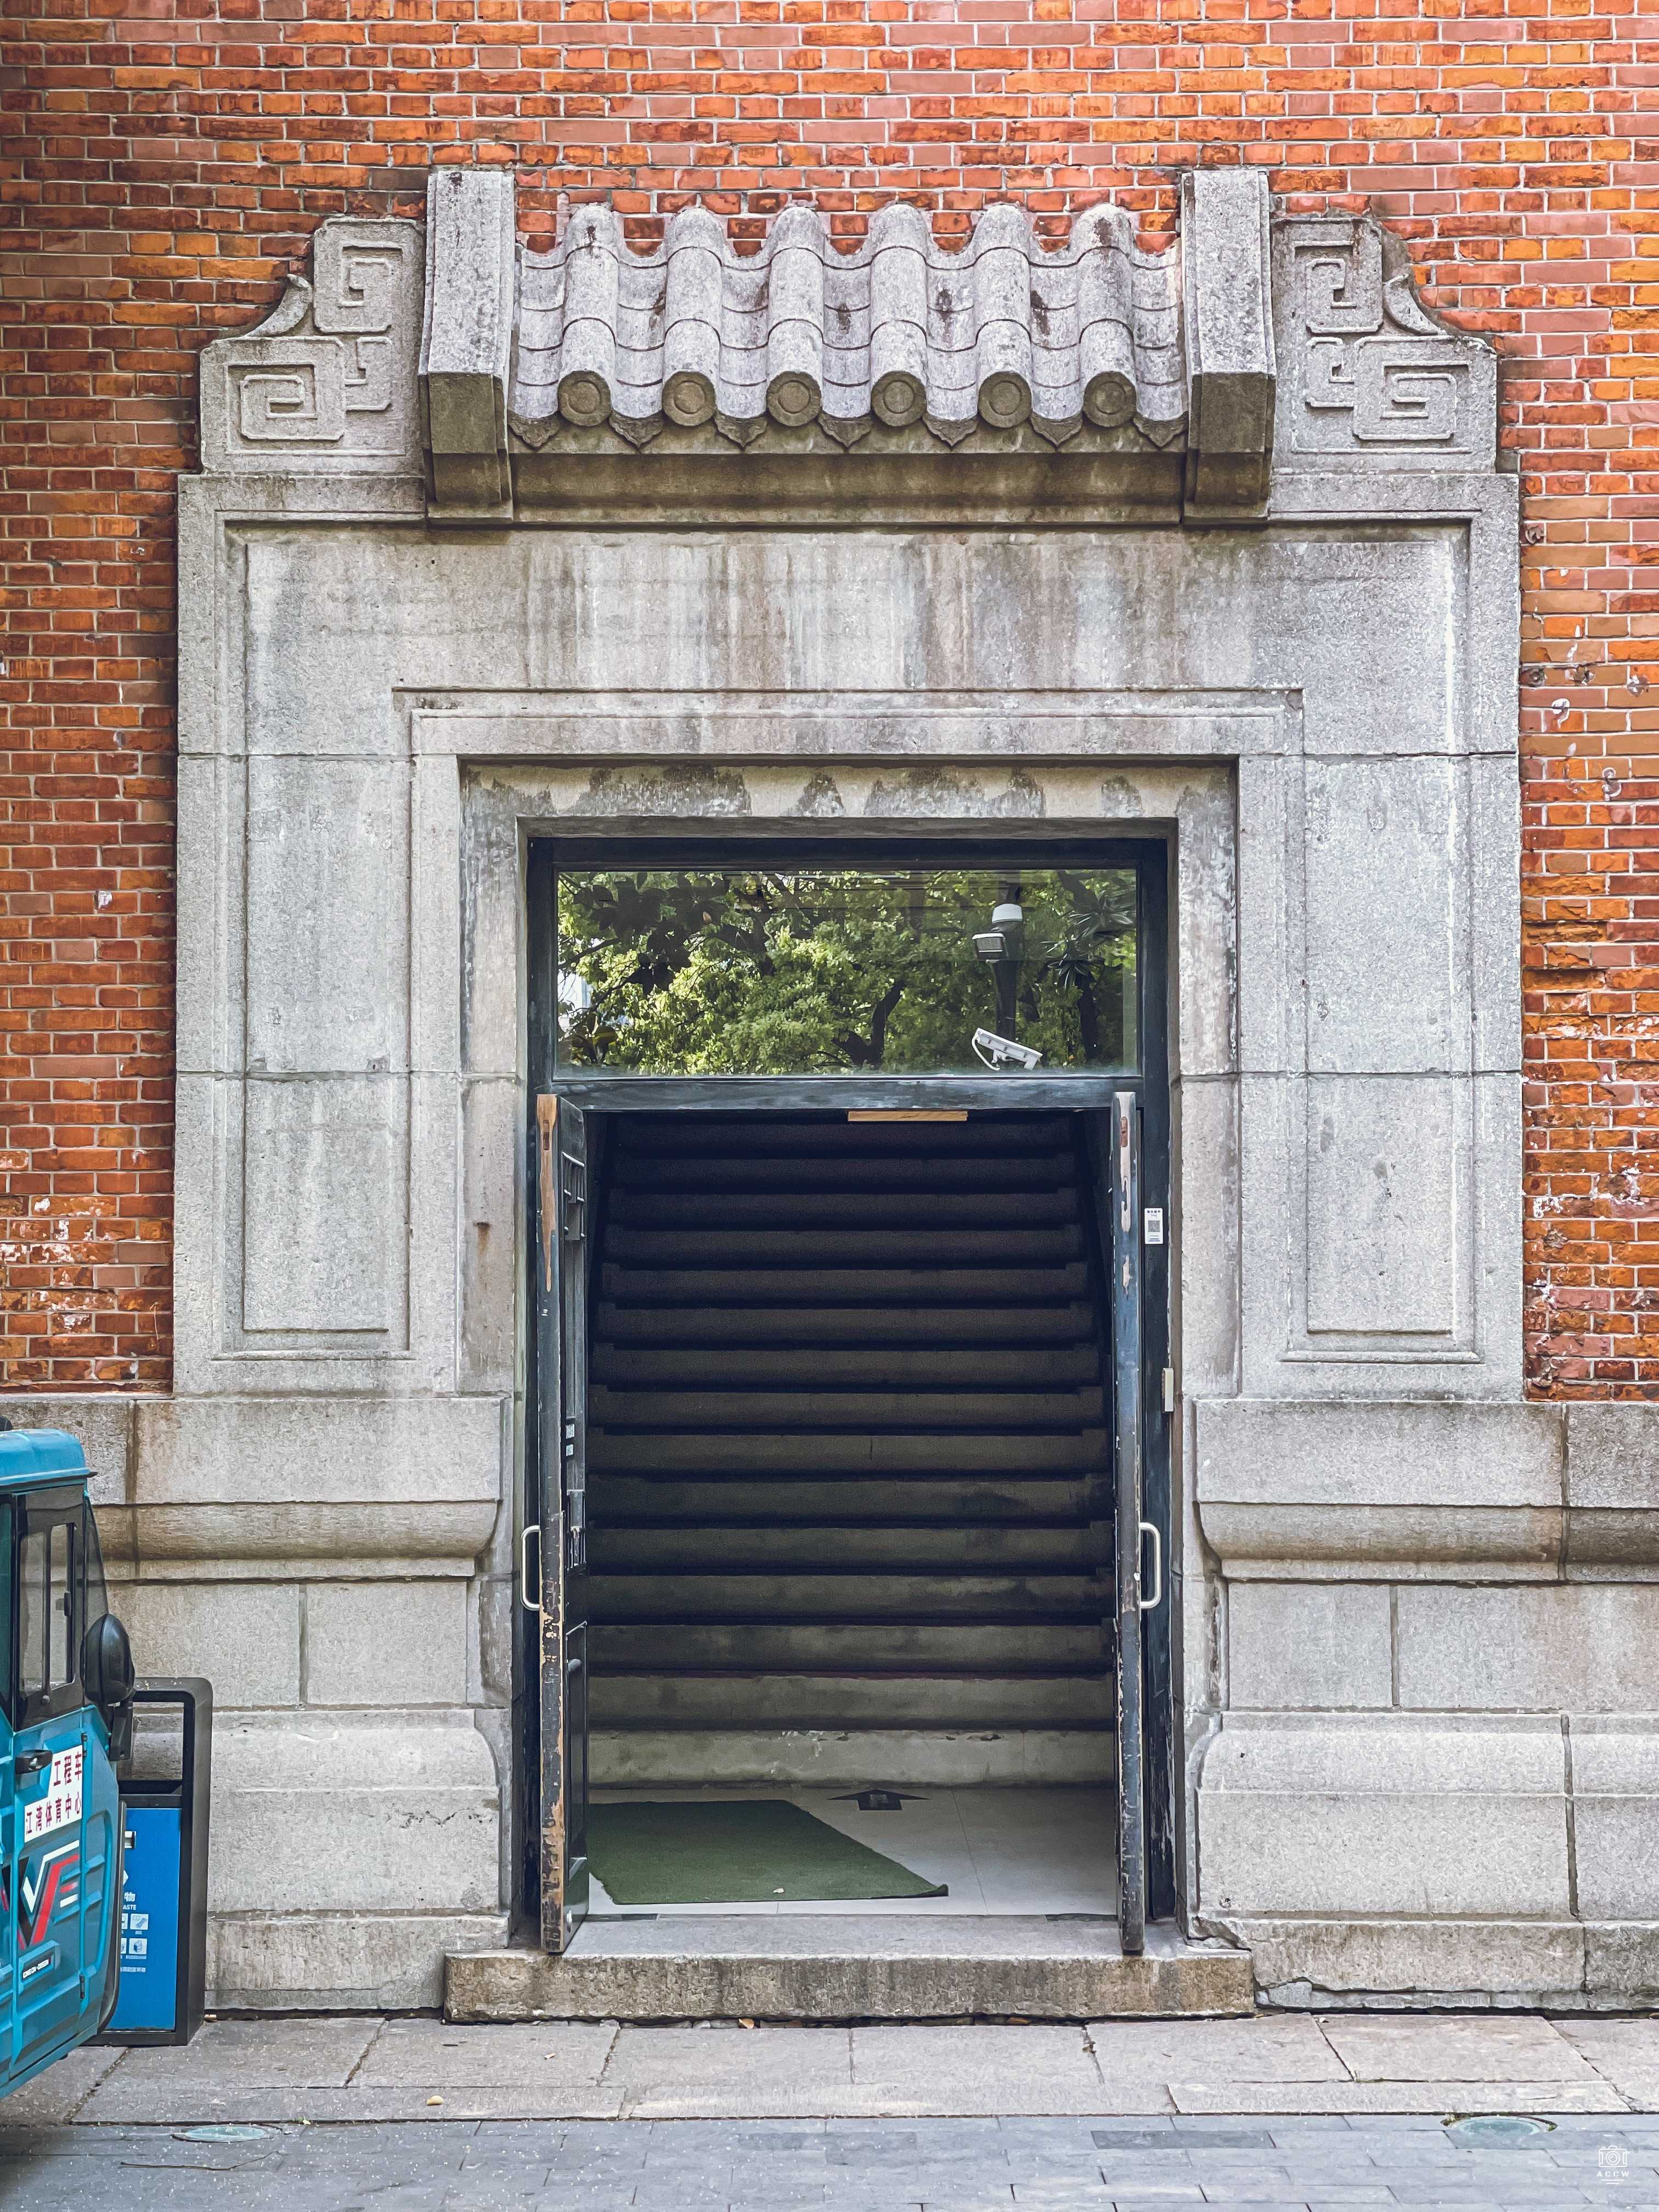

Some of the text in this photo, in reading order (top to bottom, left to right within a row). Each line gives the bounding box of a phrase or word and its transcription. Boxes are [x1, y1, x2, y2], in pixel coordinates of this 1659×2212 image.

[54, 1751, 82, 1786] 工程车
[26, 1791, 81, 1835] 江湾体育中心
